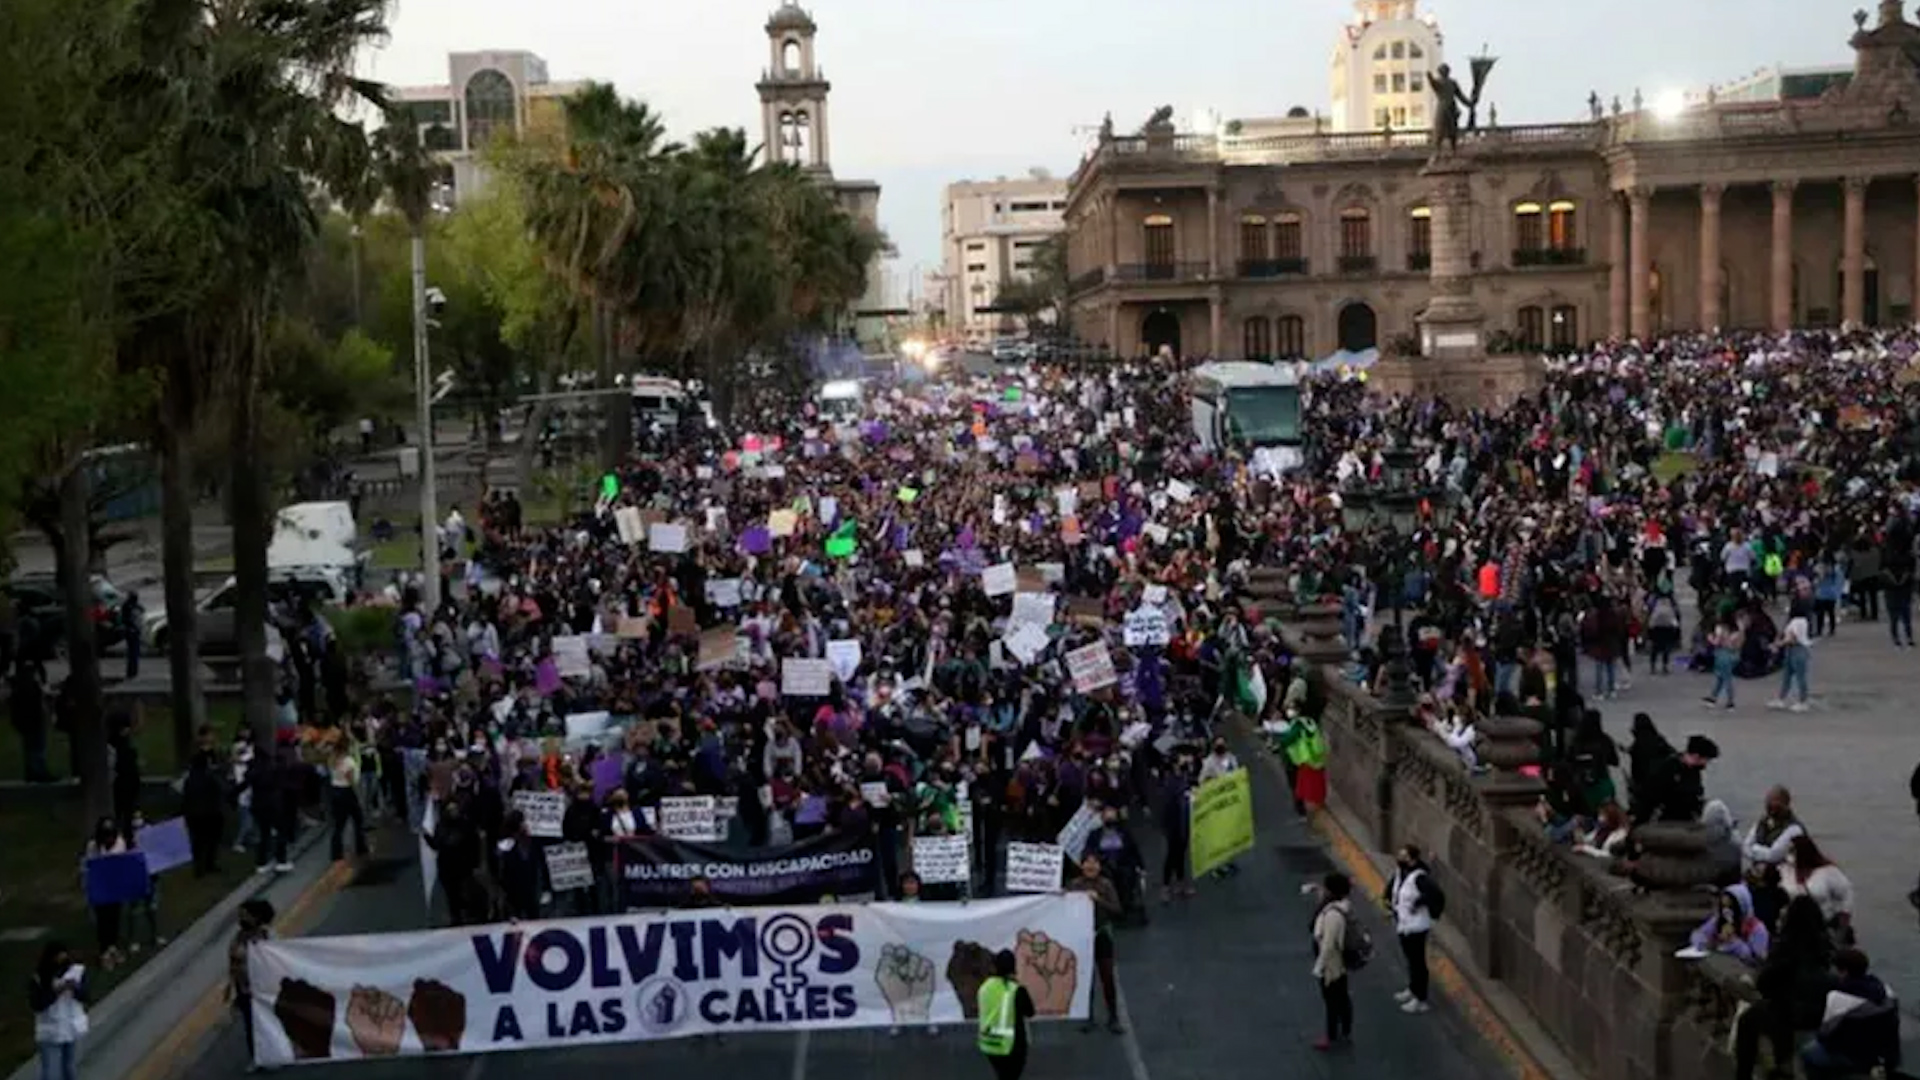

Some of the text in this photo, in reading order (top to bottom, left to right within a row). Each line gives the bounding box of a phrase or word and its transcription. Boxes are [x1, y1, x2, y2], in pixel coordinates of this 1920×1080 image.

[625, 848, 873, 879] MUJERES CON DISCAPACIDAD
[472, 913, 860, 996] VOLVIMOS
[492, 984, 858, 1042] A LAS CALLES
